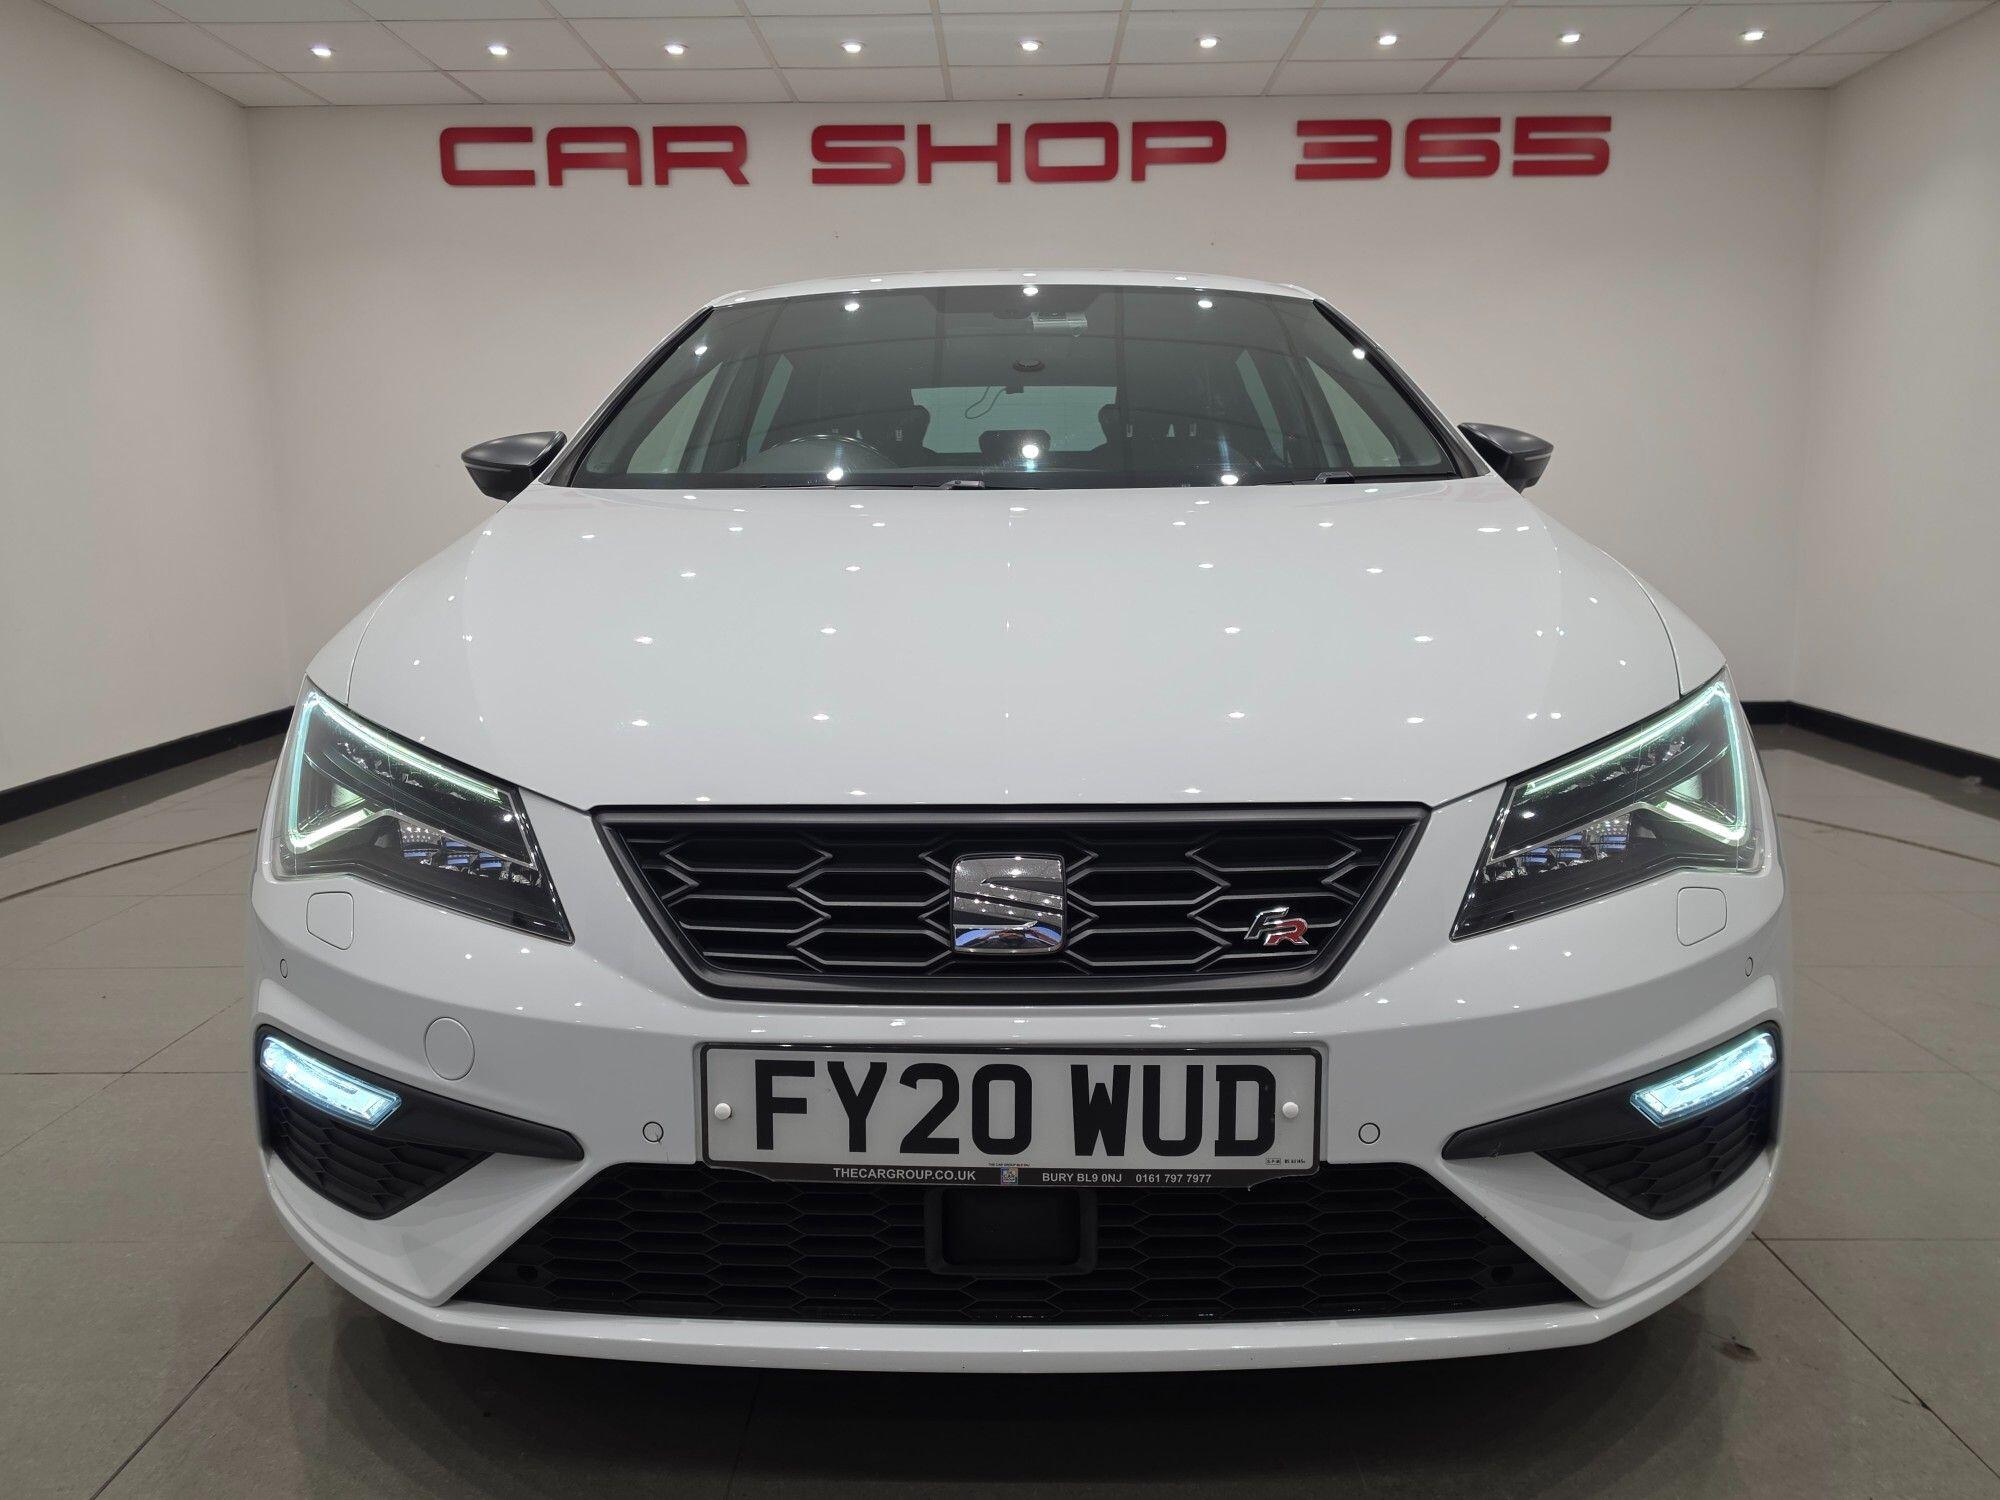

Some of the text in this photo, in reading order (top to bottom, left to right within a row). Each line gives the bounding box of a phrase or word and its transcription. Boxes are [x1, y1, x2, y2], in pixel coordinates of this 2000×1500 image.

[441, 116, 1611, 187] CAR SHOP 365
[1243, 907, 1310, 946] FR
[755, 1058, 1277, 1157] FY20 WUD
[833, 1167, 977, 1181] THECARGROUP.CO.UK
[1042, 1172, 1074, 1182] BURY
[1077, 1173, 1099, 1183] BL9
[1135, 1173, 1161, 1183] 0161
[1164, 1173, 1184, 1183] 797
[1187, 1173, 1212, 1183] 7977
